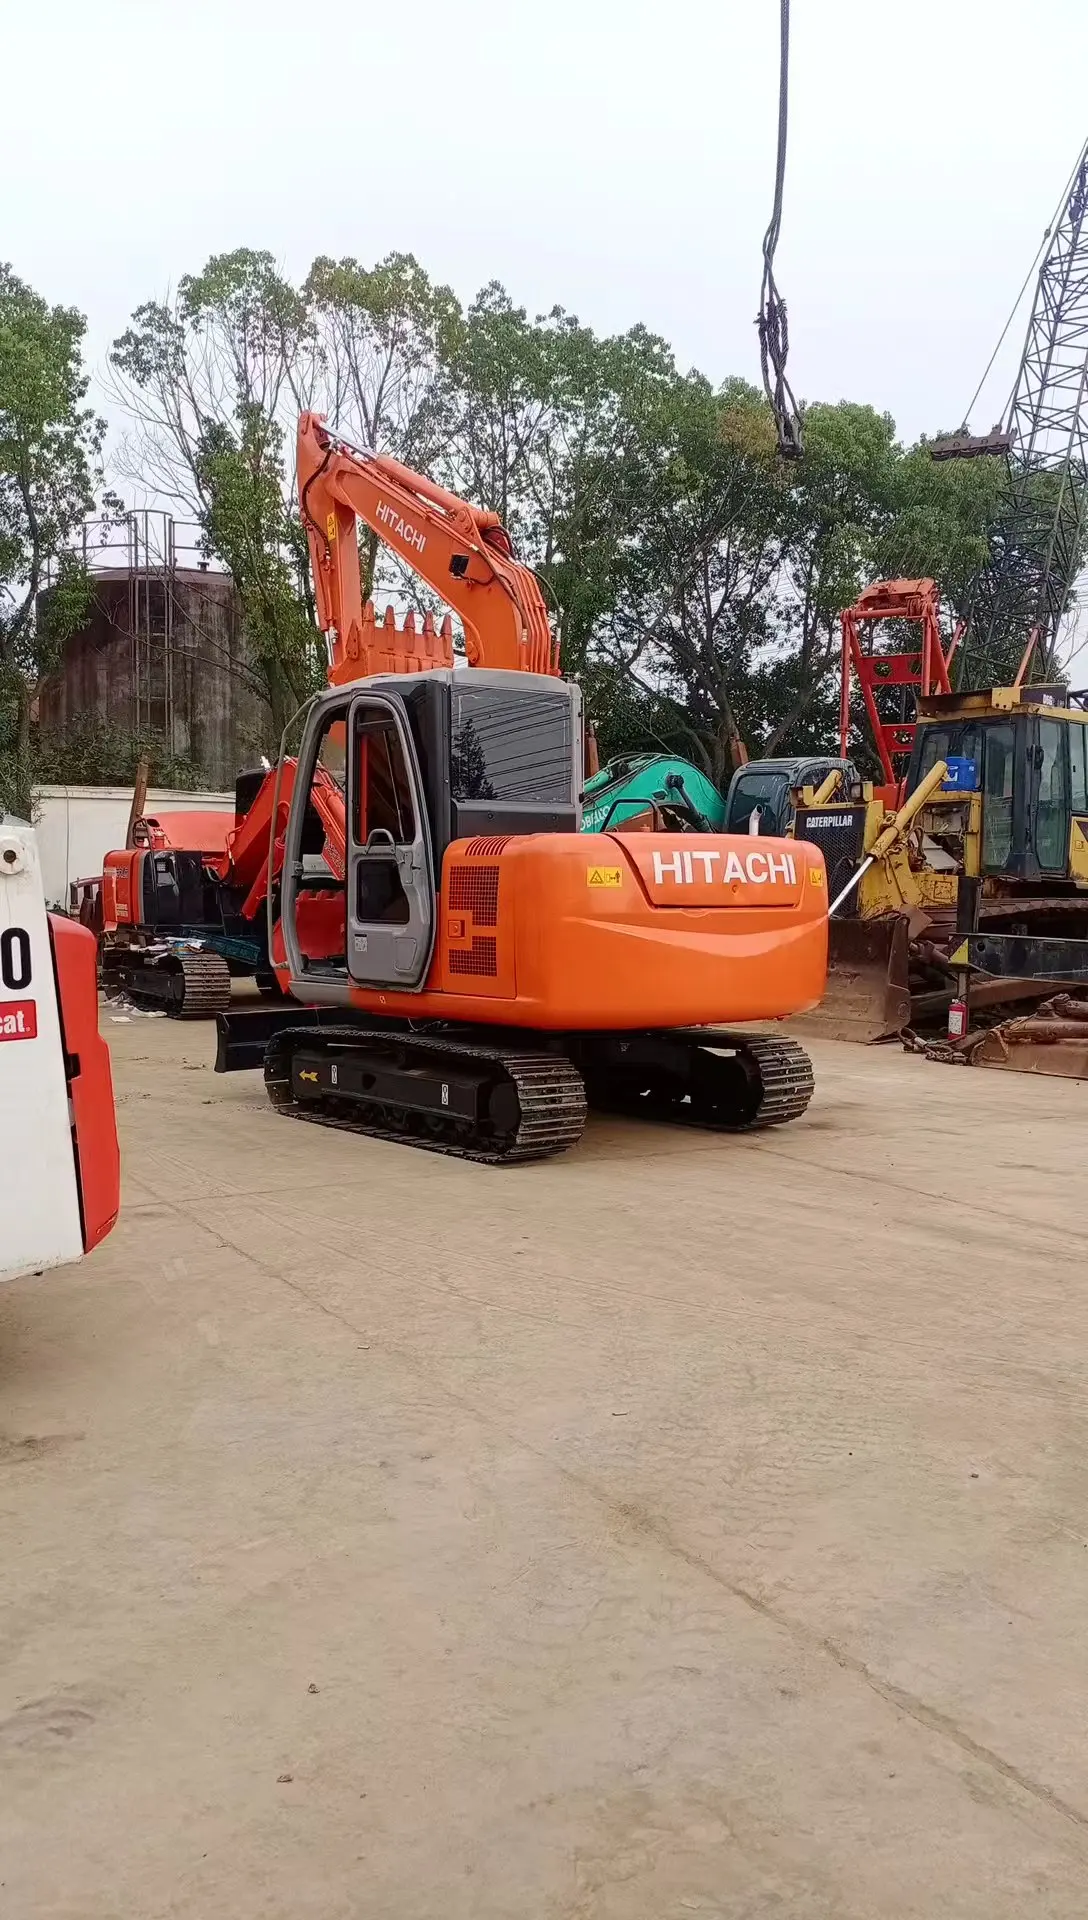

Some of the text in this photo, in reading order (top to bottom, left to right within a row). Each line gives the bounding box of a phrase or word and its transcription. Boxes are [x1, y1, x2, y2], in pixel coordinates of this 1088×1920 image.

[375, 500, 427, 553] HITACHI
[806, 815, 853, 828] CATERPILLAR
[652, 851, 797, 885] HITACHI
